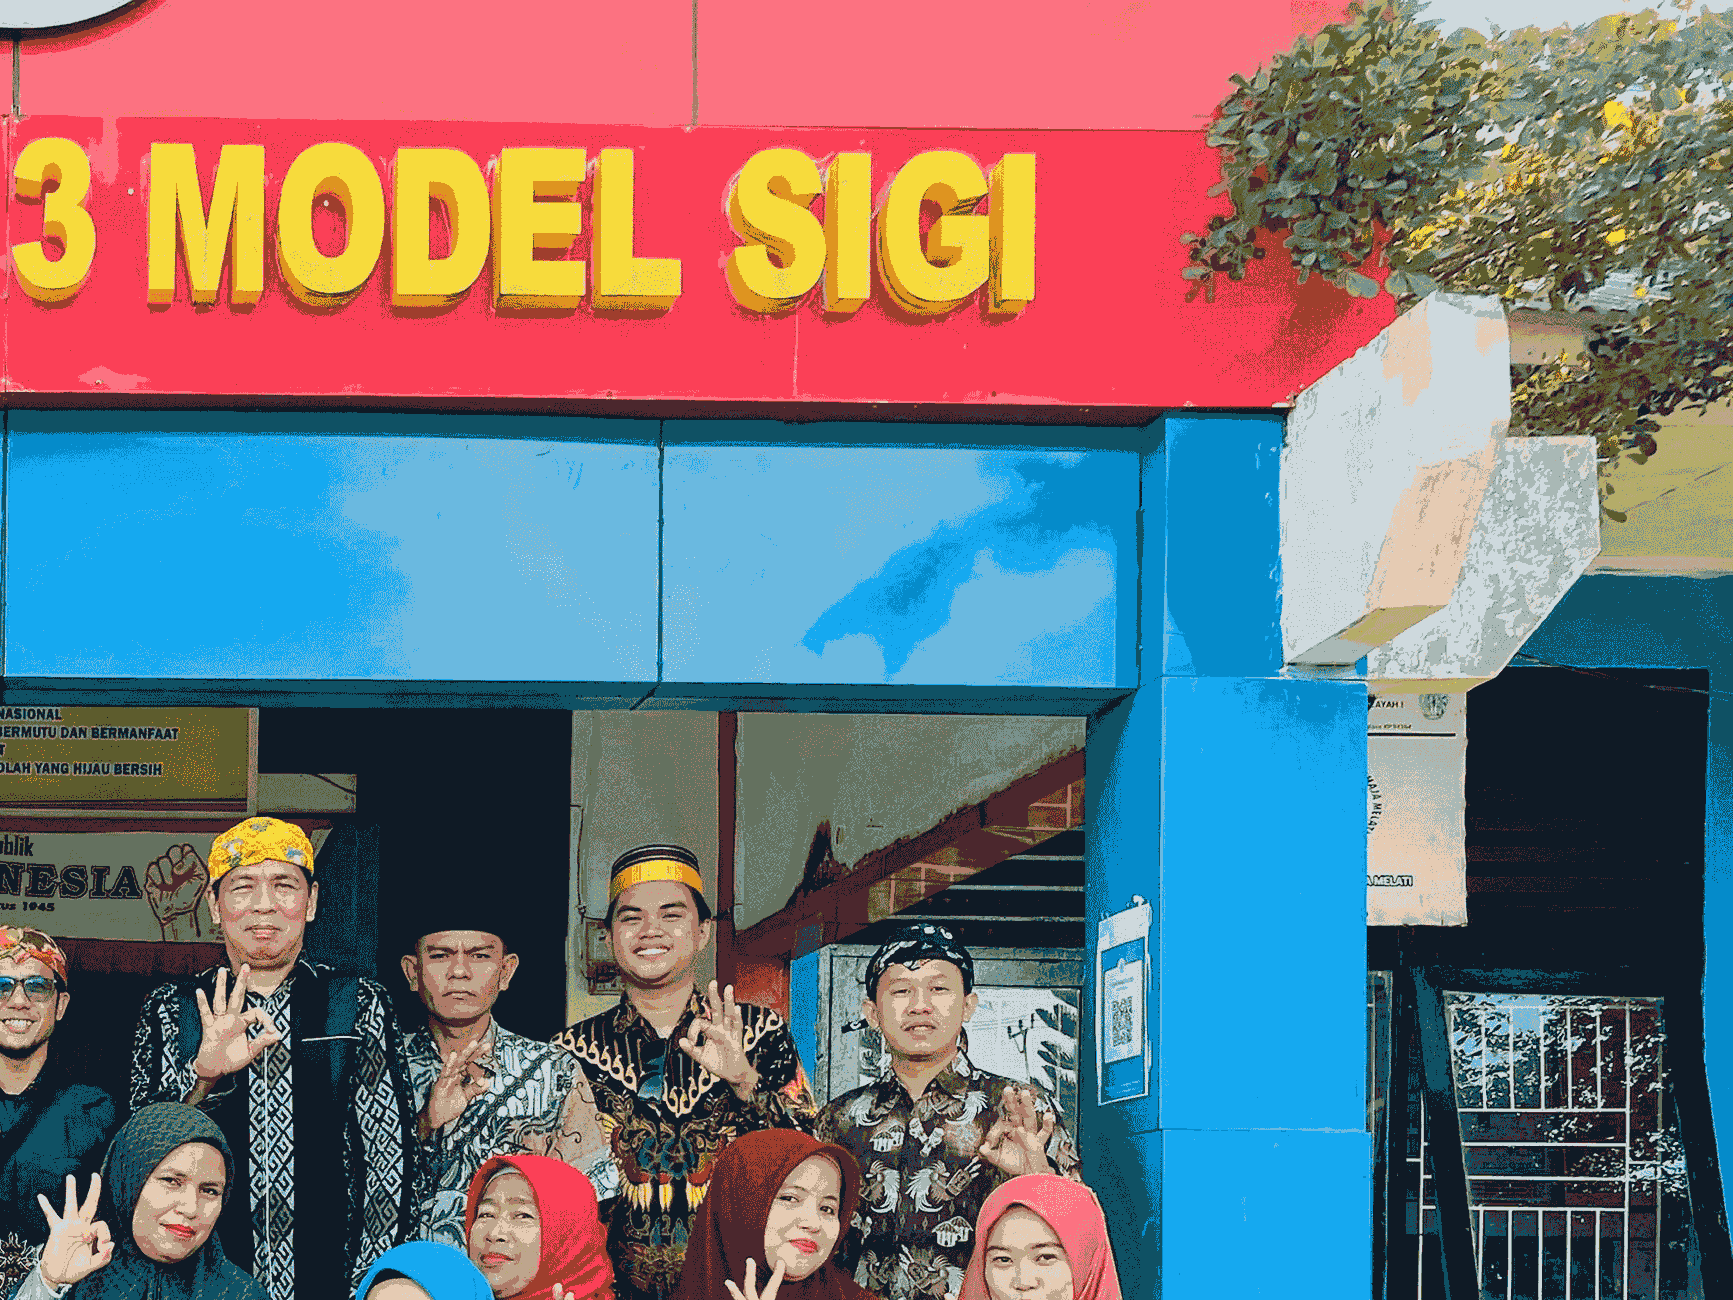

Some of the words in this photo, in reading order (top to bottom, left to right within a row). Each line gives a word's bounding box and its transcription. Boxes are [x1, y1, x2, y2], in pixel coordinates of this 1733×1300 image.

[12, 136, 96, 302] 3
[146, 141, 682, 311] MODEL
[726, 147, 1036, 315] SIGI
[60, 726, 87, 739] DAN
[91, 727, 179, 740] BERMANFAAT
[34, 762, 70, 775] YANG
[73, 763, 110, 776] HIJAU
[113, 764, 163, 776] BERSIH
[22, 901, 56, 913] 1945
